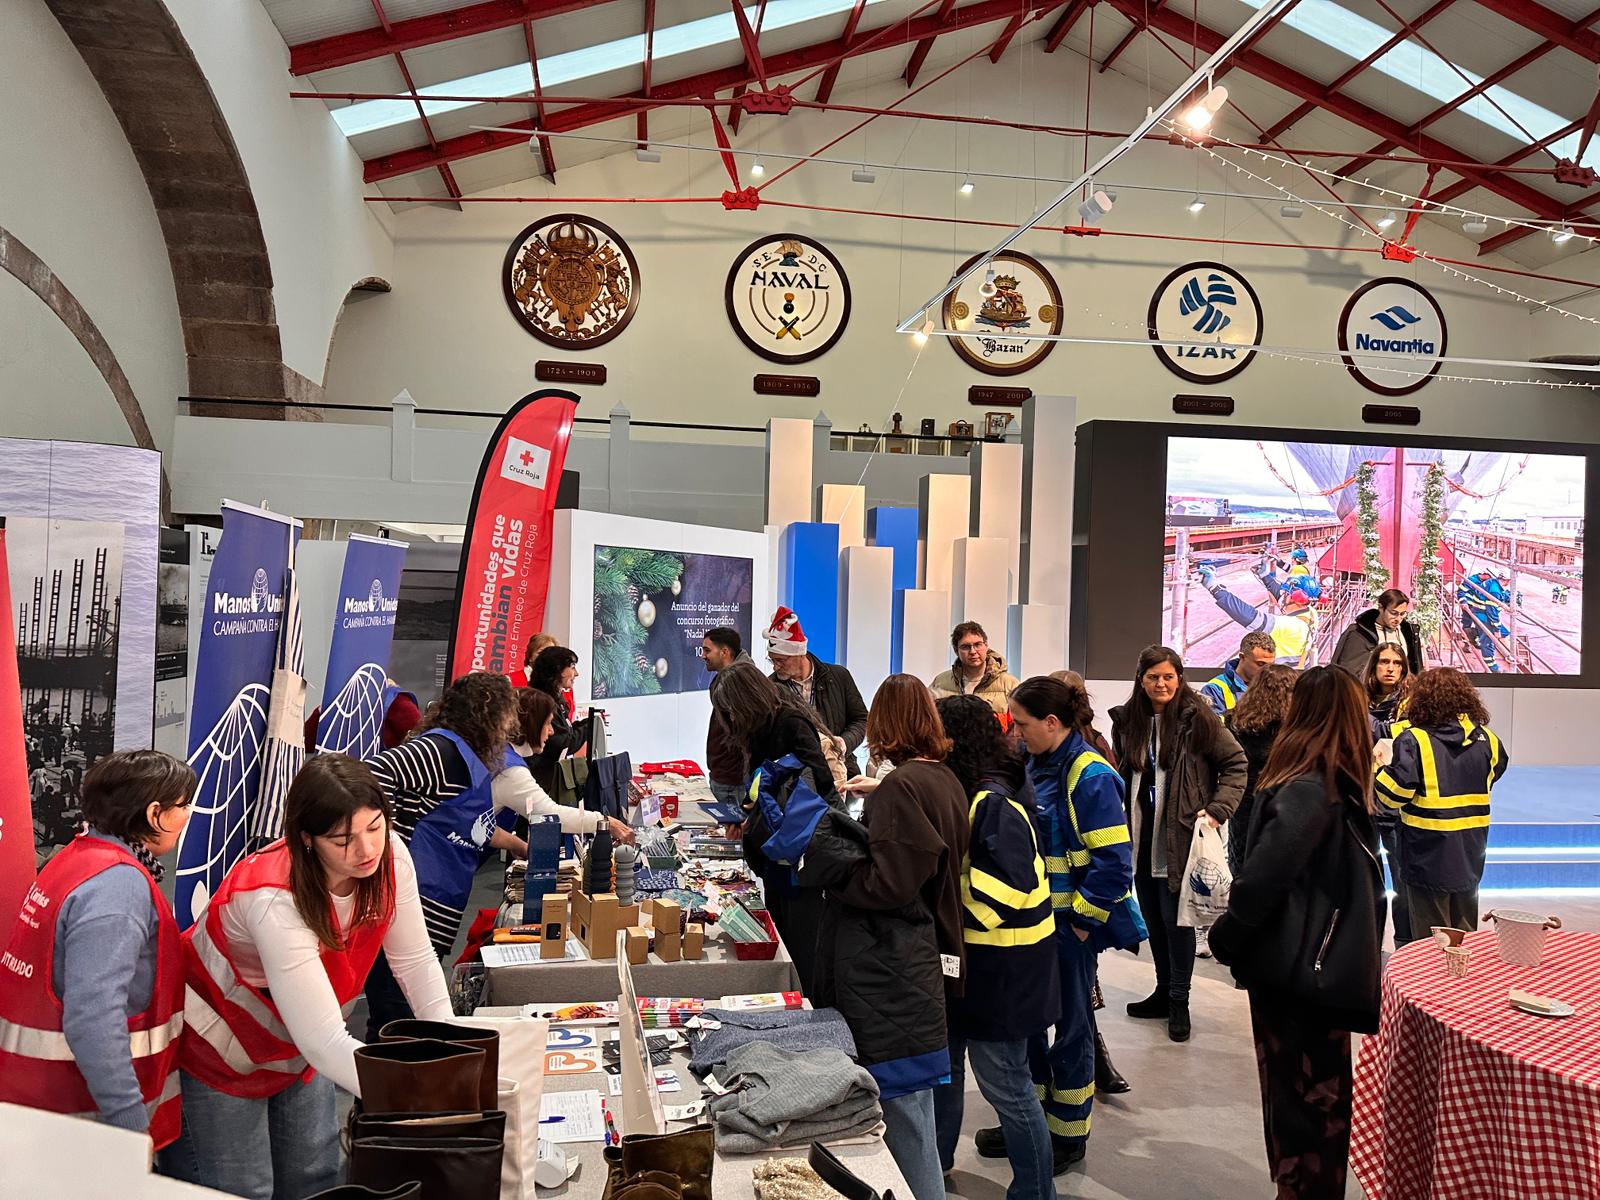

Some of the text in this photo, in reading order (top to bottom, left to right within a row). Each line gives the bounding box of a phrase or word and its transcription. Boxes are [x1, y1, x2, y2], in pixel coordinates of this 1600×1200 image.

[750, 270, 830, 290] NAVAL
[1355, 333, 1434, 354] Navantia
[577, 369, 596, 377] 1909
[509, 464, 540, 480] Cruz Roja
[491, 514, 505, 549] que
[524, 524, 539, 549] Roja
[520, 551, 534, 577] Cruz
[488, 519, 523, 672] ambian vidas
[517, 579, 528, 595] de
[214, 592, 251, 614] Manos
[344, 597, 369, 613] Manos
[671, 601, 740, 614] Anuncio del ganador del
[213, 617, 247, 636] CAMPAÑA
[511, 596, 526, 641] Empleo
[677, 615, 735, 627] concurso fotográfico
[508, 643, 519, 659] de
